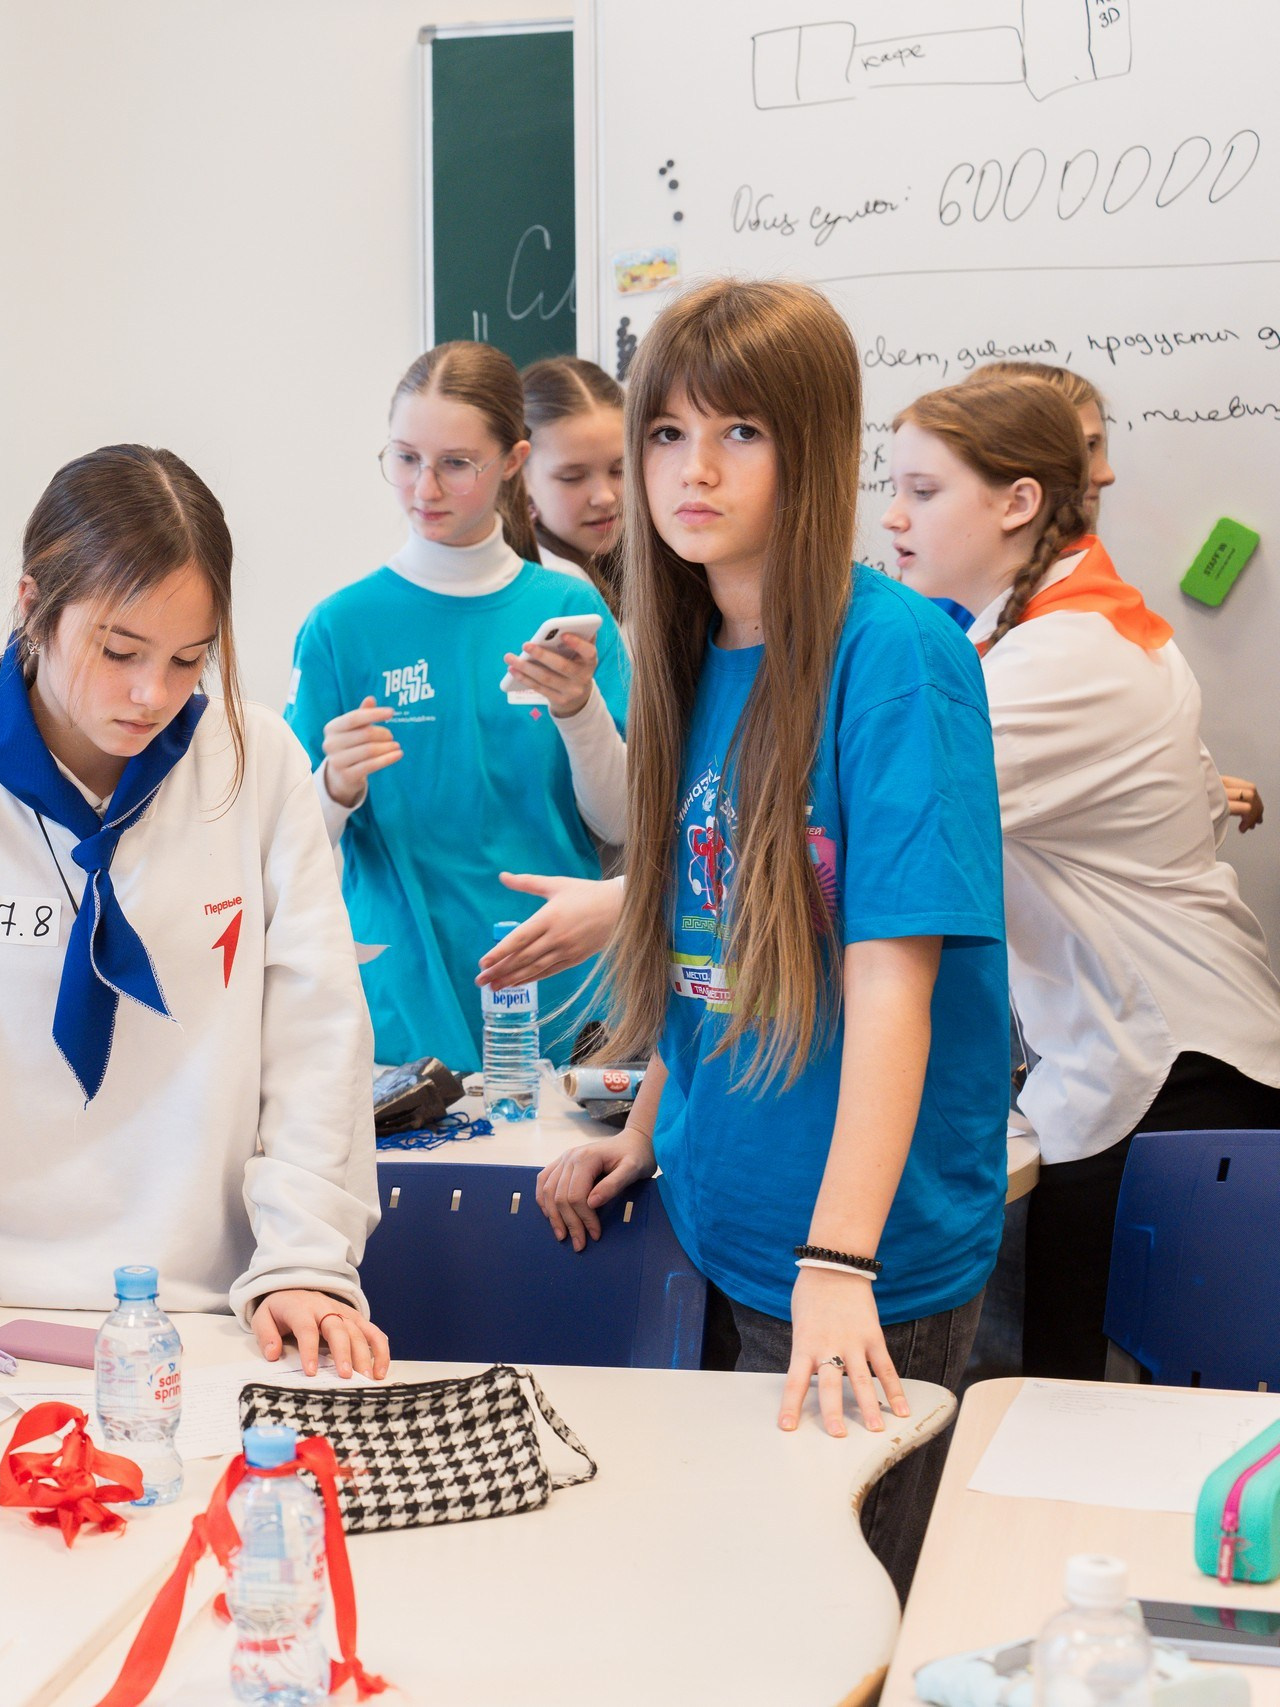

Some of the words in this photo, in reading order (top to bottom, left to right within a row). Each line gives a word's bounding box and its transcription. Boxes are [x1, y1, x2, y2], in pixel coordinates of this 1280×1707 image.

[860, 44, 926, 71] кафе
[1087, 328, 1240, 365] продукты
[204, 895, 243, 916] Первые
[604, 1072, 630, 1085] 365
[154, 1384, 181, 1404] sprin
